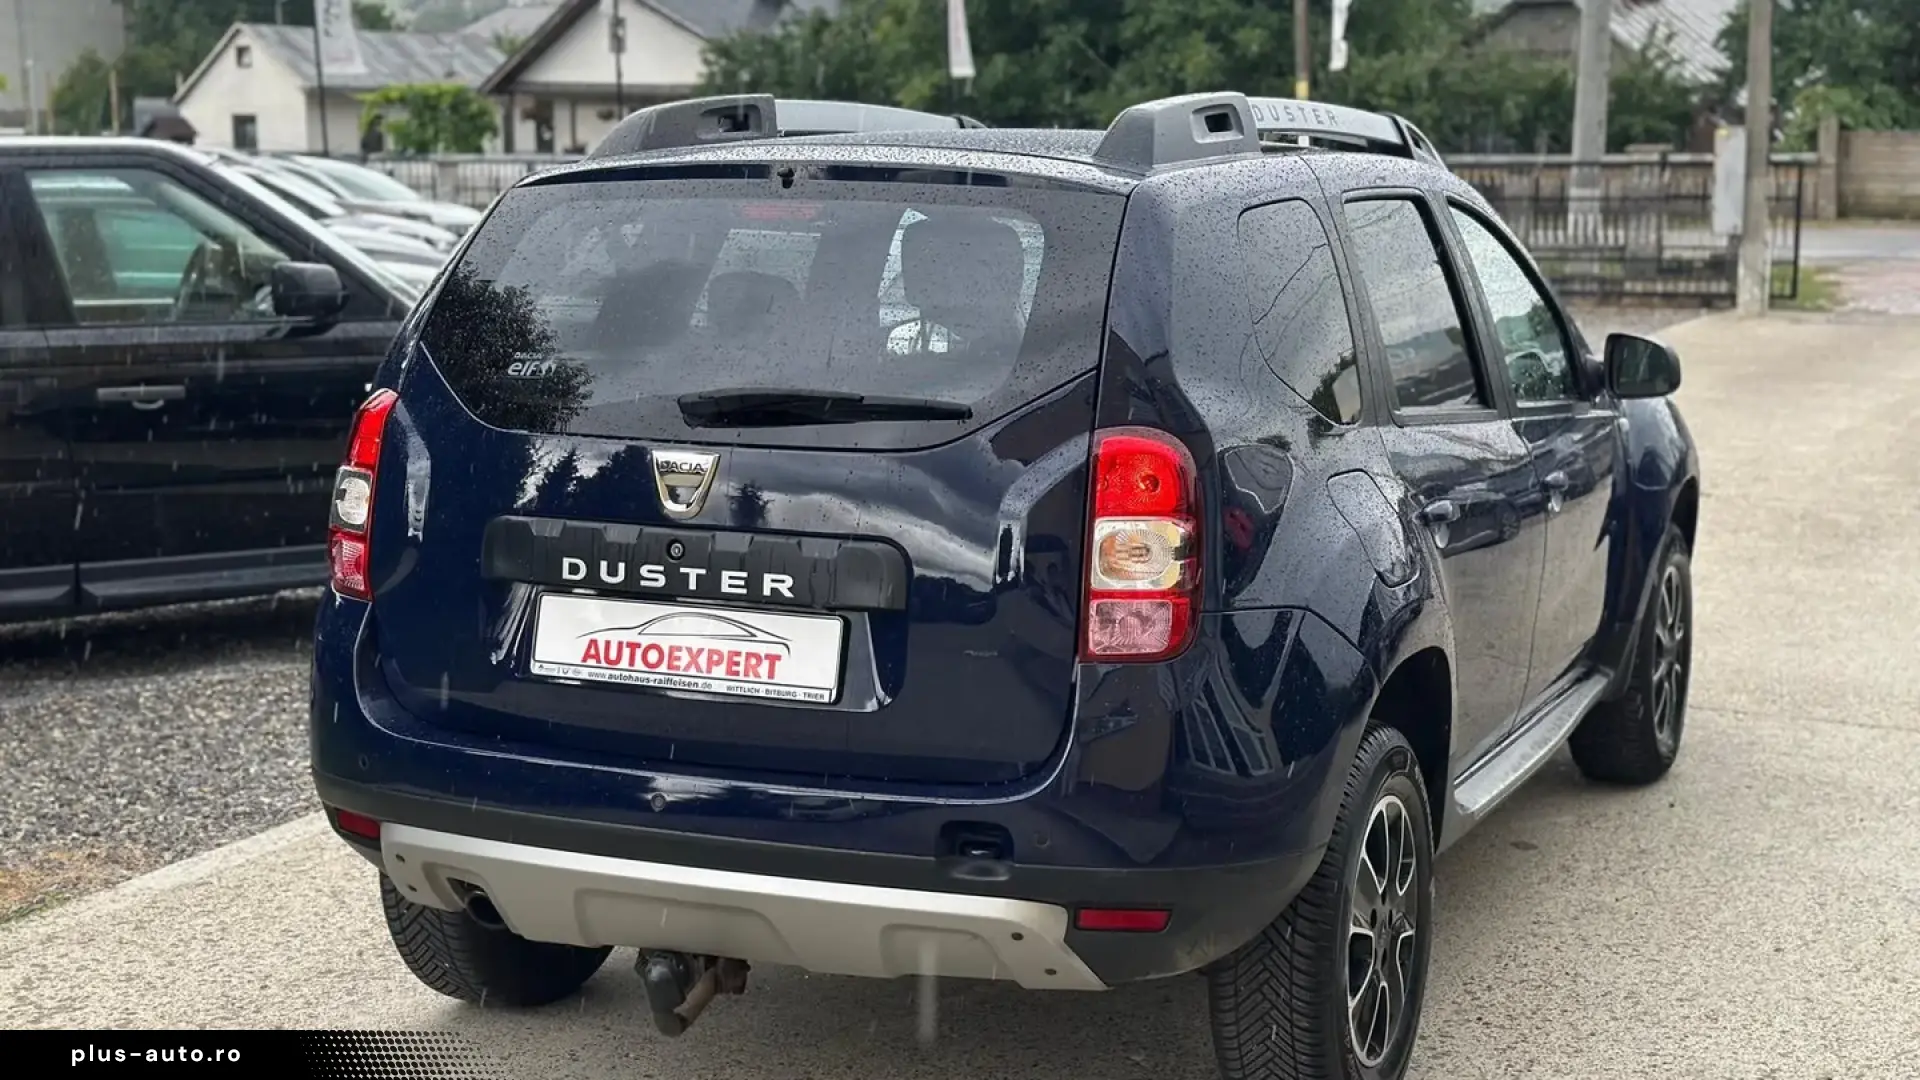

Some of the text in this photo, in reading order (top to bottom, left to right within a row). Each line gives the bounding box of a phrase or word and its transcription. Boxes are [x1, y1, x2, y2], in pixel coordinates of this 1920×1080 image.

[1252, 104, 1339, 127] DUSTER
[659, 460, 706, 473] DACIA
[561, 556, 795, 598] DUSTER
[580, 637, 783, 681] AUTOEXPERT
[587, 669, 713, 690] www.autohaus-raiffeisen.de
[764, 688, 798, 698] BITBURG
[803, 691, 825, 701] TRIER
